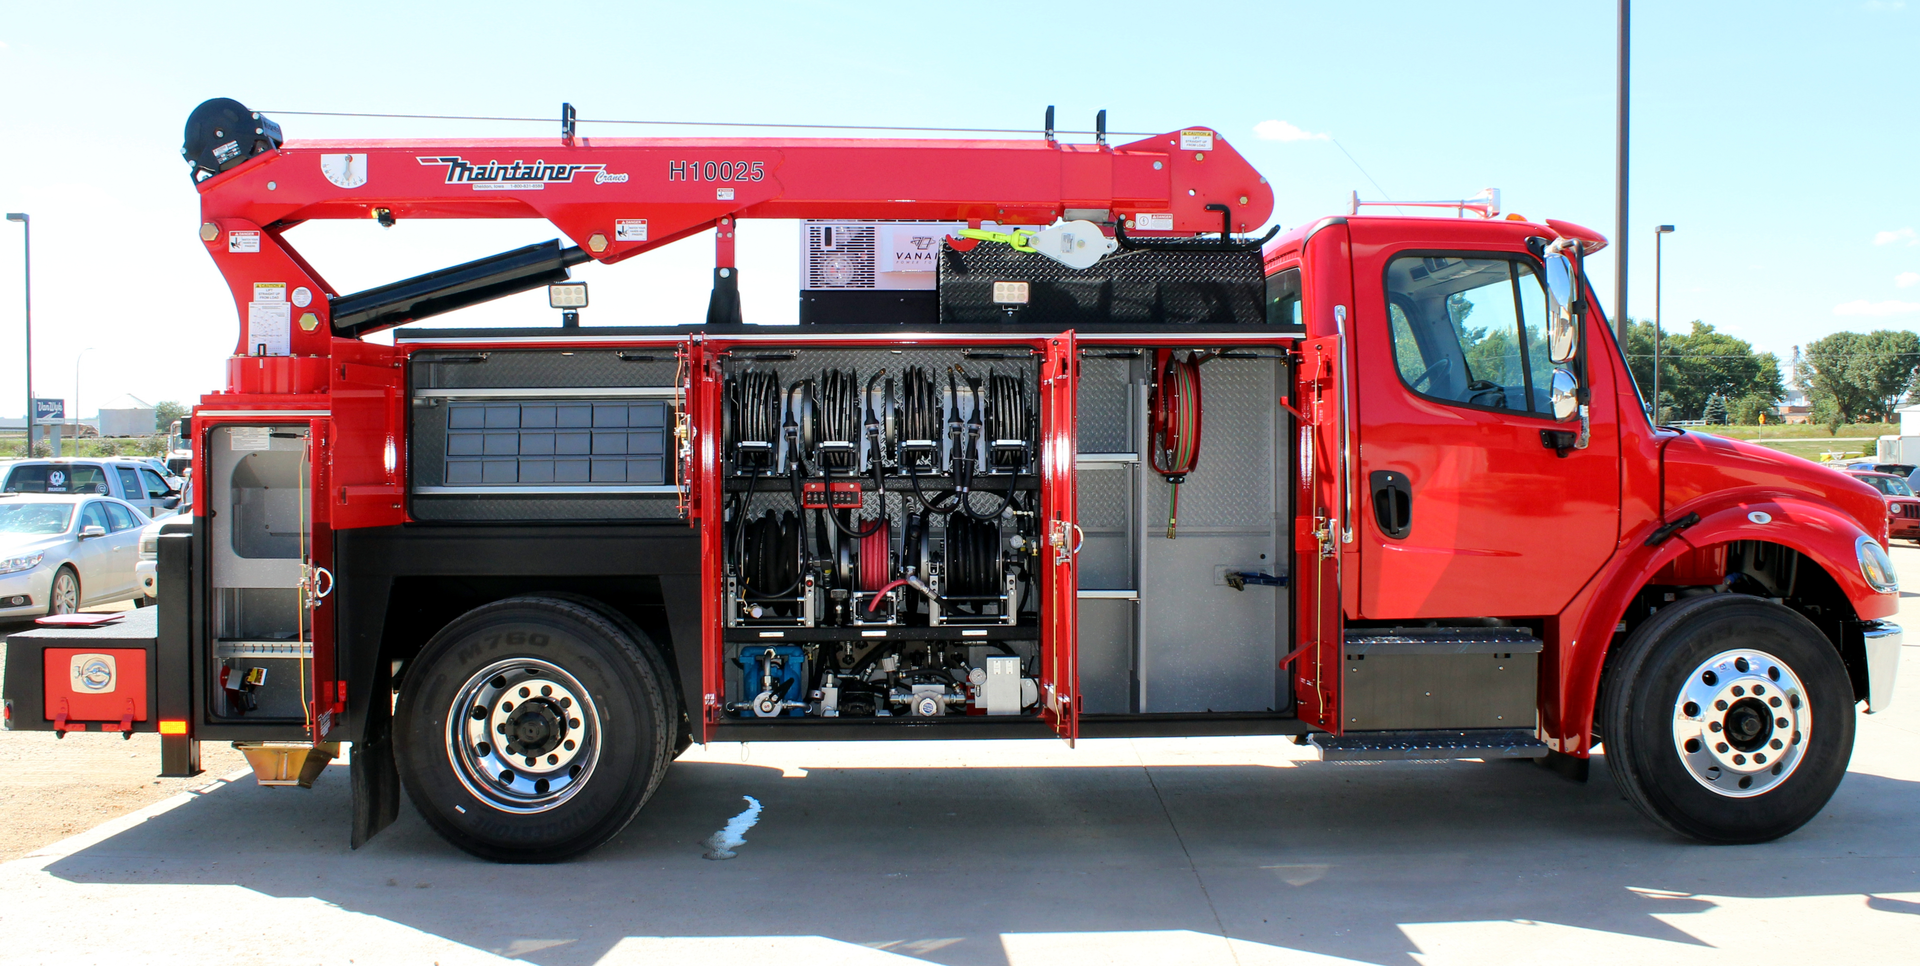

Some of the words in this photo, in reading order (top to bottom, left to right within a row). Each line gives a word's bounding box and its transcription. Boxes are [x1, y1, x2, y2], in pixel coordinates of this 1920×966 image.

[434, 156, 586, 184] Maintainer
[594, 171, 628, 184] Cranes
[669, 160, 765, 182] H10025
